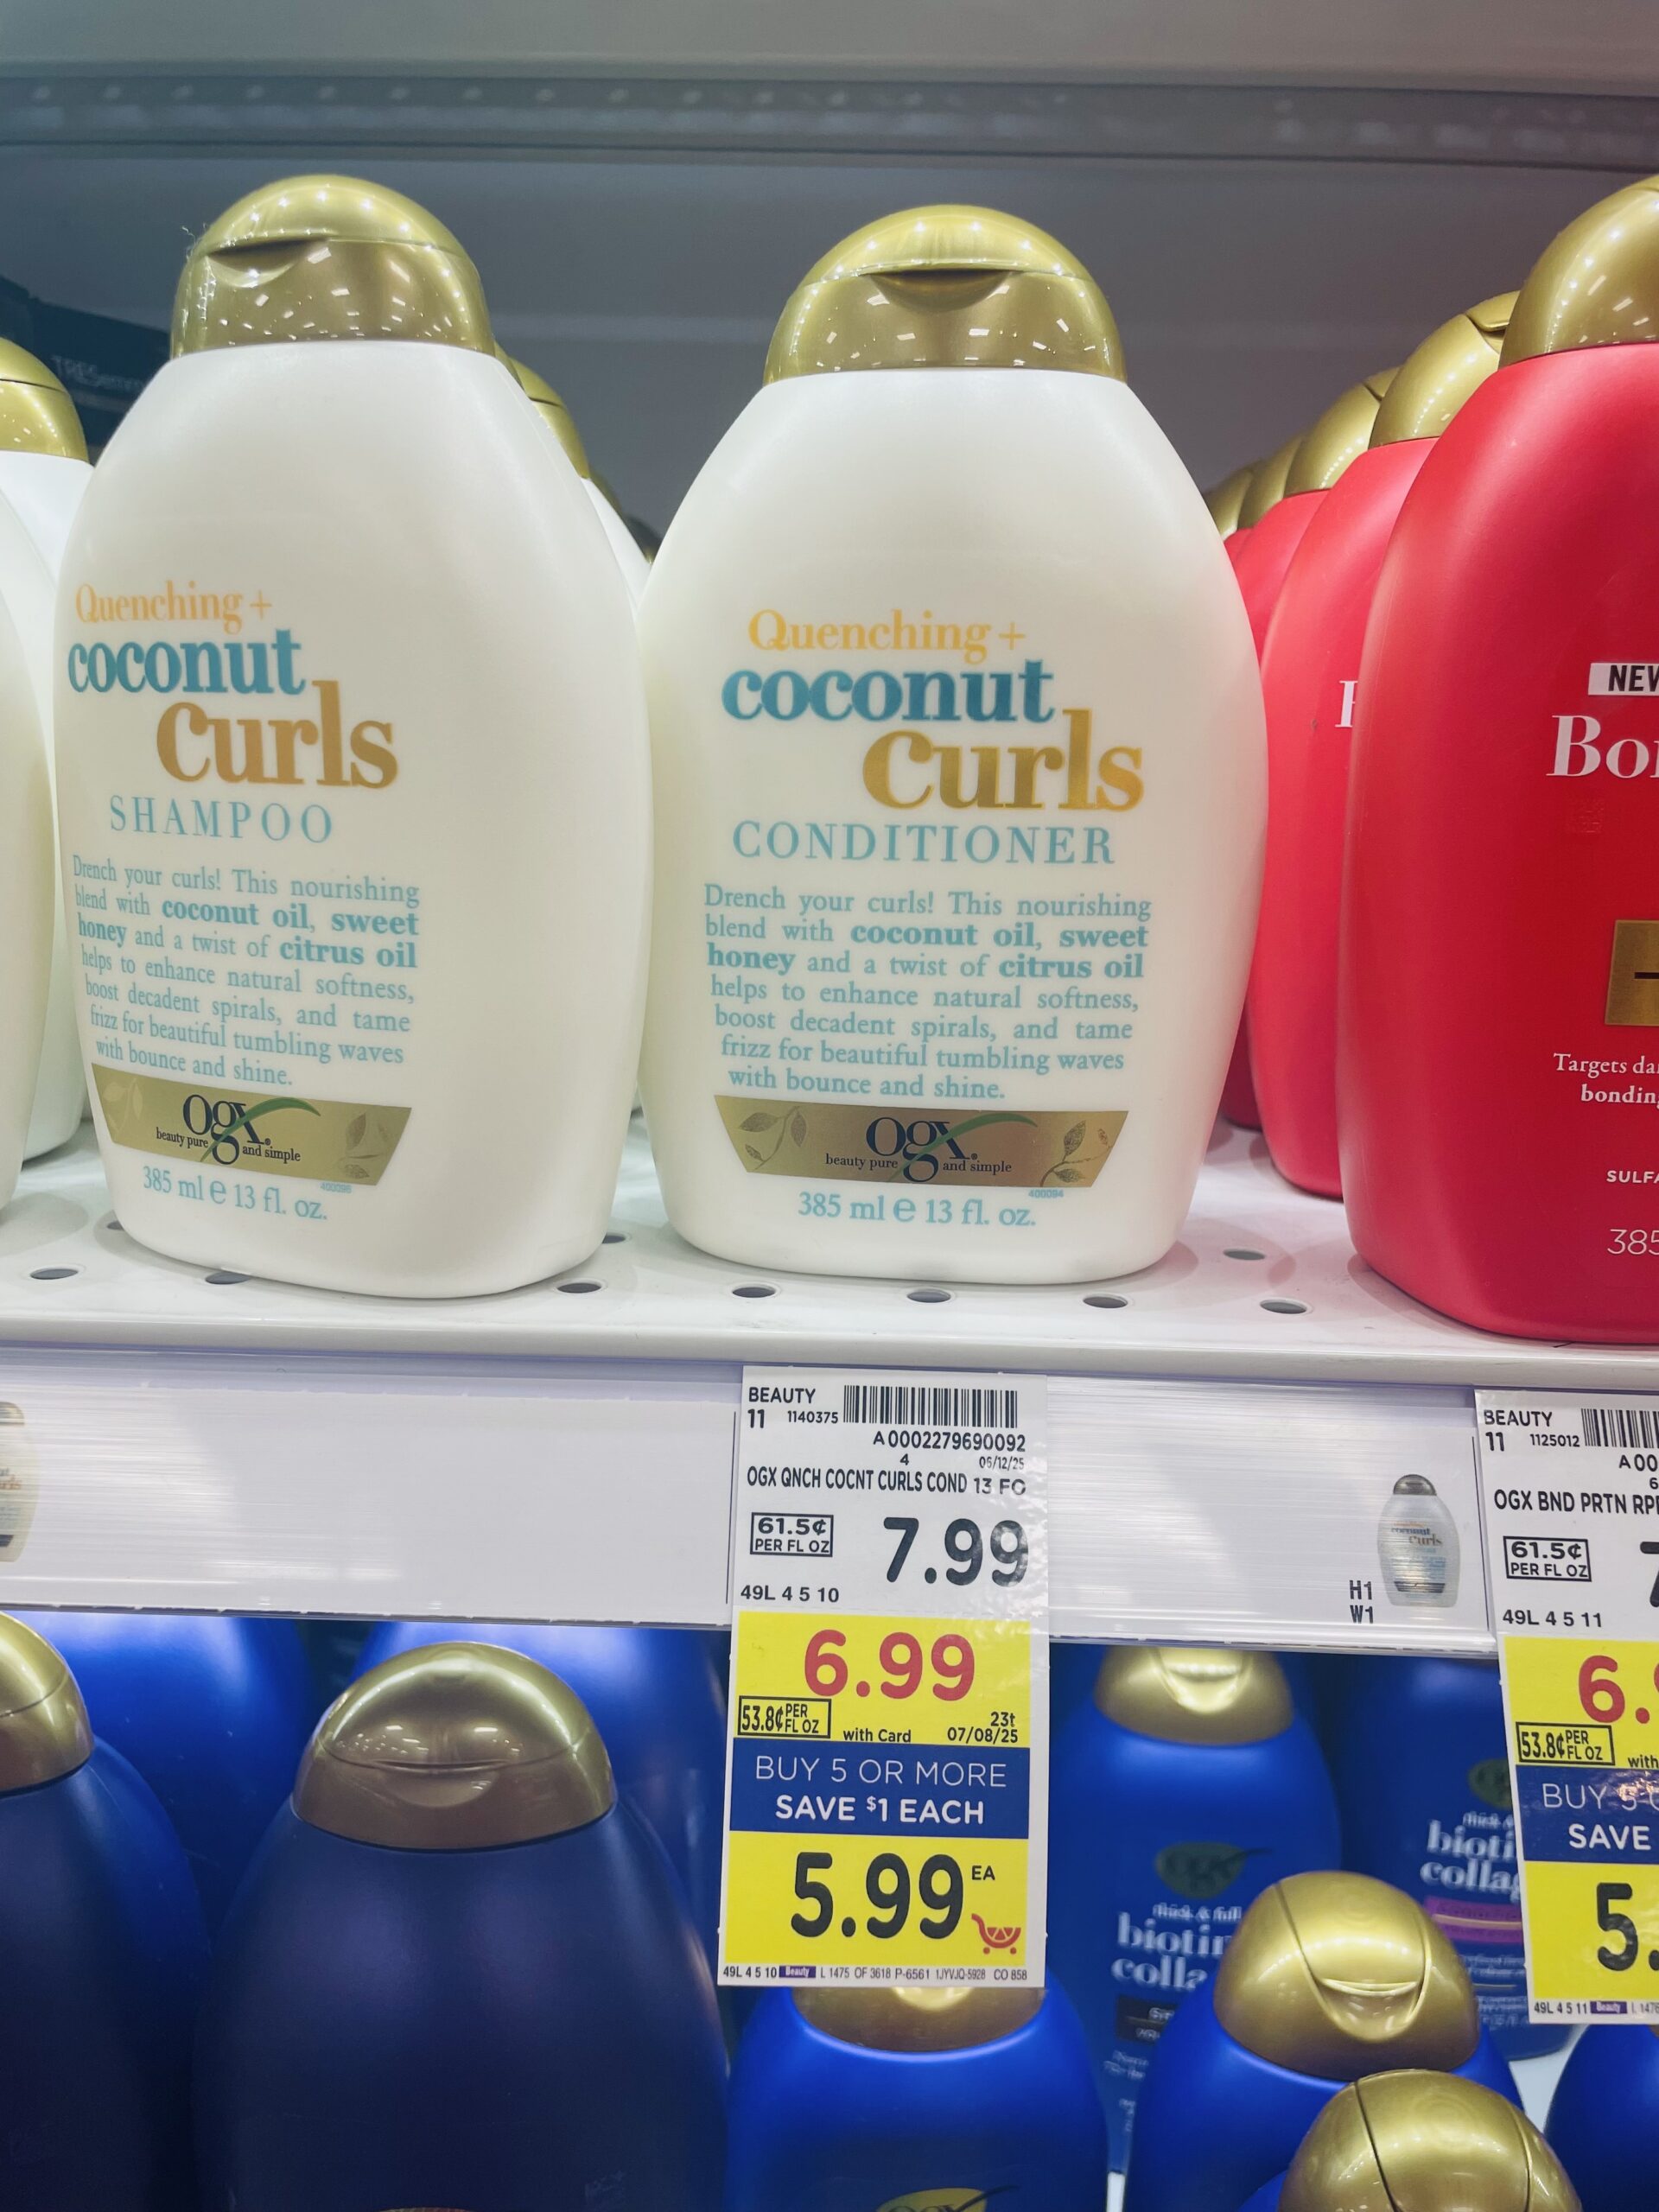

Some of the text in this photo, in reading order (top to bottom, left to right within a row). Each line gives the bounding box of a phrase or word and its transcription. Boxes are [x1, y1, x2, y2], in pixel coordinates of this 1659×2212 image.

[76, 581, 243, 634] Quenching
[749, 609, 991, 664] Quenching
[68, 629, 306, 695] coconut
[721, 659, 1055, 722] coconut
[157, 680, 398, 789] Curls
[1546, 715, 1659, 779] Bo
[863, 709, 1144, 811] Curls
[111, 795, 332, 843] SHAMPOO
[733, 821, 1115, 864] CONDITIONER
[73, 855, 419, 908] Drench your curls! This nourishing
[704, 884, 1151, 921] Drench your curls! This nourishing
[706, 914, 1148, 950] blend with coconut oil, sweet
[708, 943, 1143, 978] honey and twist of citrus oil
[1554, 1053, 1626, 1079] Targets
[156, 1127, 301, 1162] beauty pure and simple
[825, 1154, 1012, 1175] beauty pure and simple
[143, 1166, 327, 1219] 385 ml 13 fl. oz.
[798, 1192, 841, 1217] 385
[849, 1195, 885, 1221] ml
[926, 1199, 952, 1224] 13
[963, 1199, 989, 1225] fl.
[999, 1207, 1036, 1226] oz.
[749, 1387, 816, 1403] BEAUTY
[747, 1408, 838, 1428] 11 1140375
[1484, 1410, 1552, 1426] BEAUTY
[1486, 1432, 1580, 1451] 11 1125012
[900, 1453, 909, 1465] 4
[747, 1466, 1026, 1496] OGX QNCH COCNT CURLS COND 13 FO
[1494, 1490, 1532, 1510] OGX
[1538, 1491, 1574, 1512] BND
[1581, 1493, 1626, 1513] PRTN
[758, 1517, 826, 1535] 61.5¢
[754, 1538, 830, 1553] PER FL OZ
[883, 1517, 1028, 1587] 7.99
[1511, 1541, 1581, 1560] 61.5¢
[1510, 1563, 1587, 1577] PER FL OZ
[741, 1586, 839, 1603] 49L 4 5 10
[1350, 1580, 1372, 1599] H1
[1350, 1605, 1373, 1624] W1
[1503, 1609, 1601, 1628] 49L 11
[804, 1630, 975, 1701] 6.99
[741, 1703, 807, 1732] 53.8¢ PER
[785, 1719, 818, 1733] FL OZ
[843, 1729, 911, 1743] with Card
[947, 1726, 1018, 1745] 07/08/25
[1521, 1731, 1589, 1758] 53.8¢ PER
[1567, 1745, 1603, 1761] FL OZ
[757, 1756, 1007, 1787] BUY 5 OR MORE
[776, 1796, 983, 1824] SAVE $1 EACH
[1542, 1783, 1607, 1811] BUY
[1569, 1823, 1651, 1851] SAVE
[791, 1852, 995, 1938] 5.99 EA
[723, 1967, 742, 1977] 49L
[766, 1967, 777, 1978] 10
[830, 1967, 849, 1978] 1475
[855, 1967, 868, 1978] OF
[870, 1968, 891, 1979] 3618
[895, 1968, 929, 1980] P-6561
[995, 1969, 1007, 1980] CO
[1011, 1970, 1027, 1980] 858
[1535, 2002, 1554, 2013] 49L
[1577, 2003, 1586, 2013] 11
